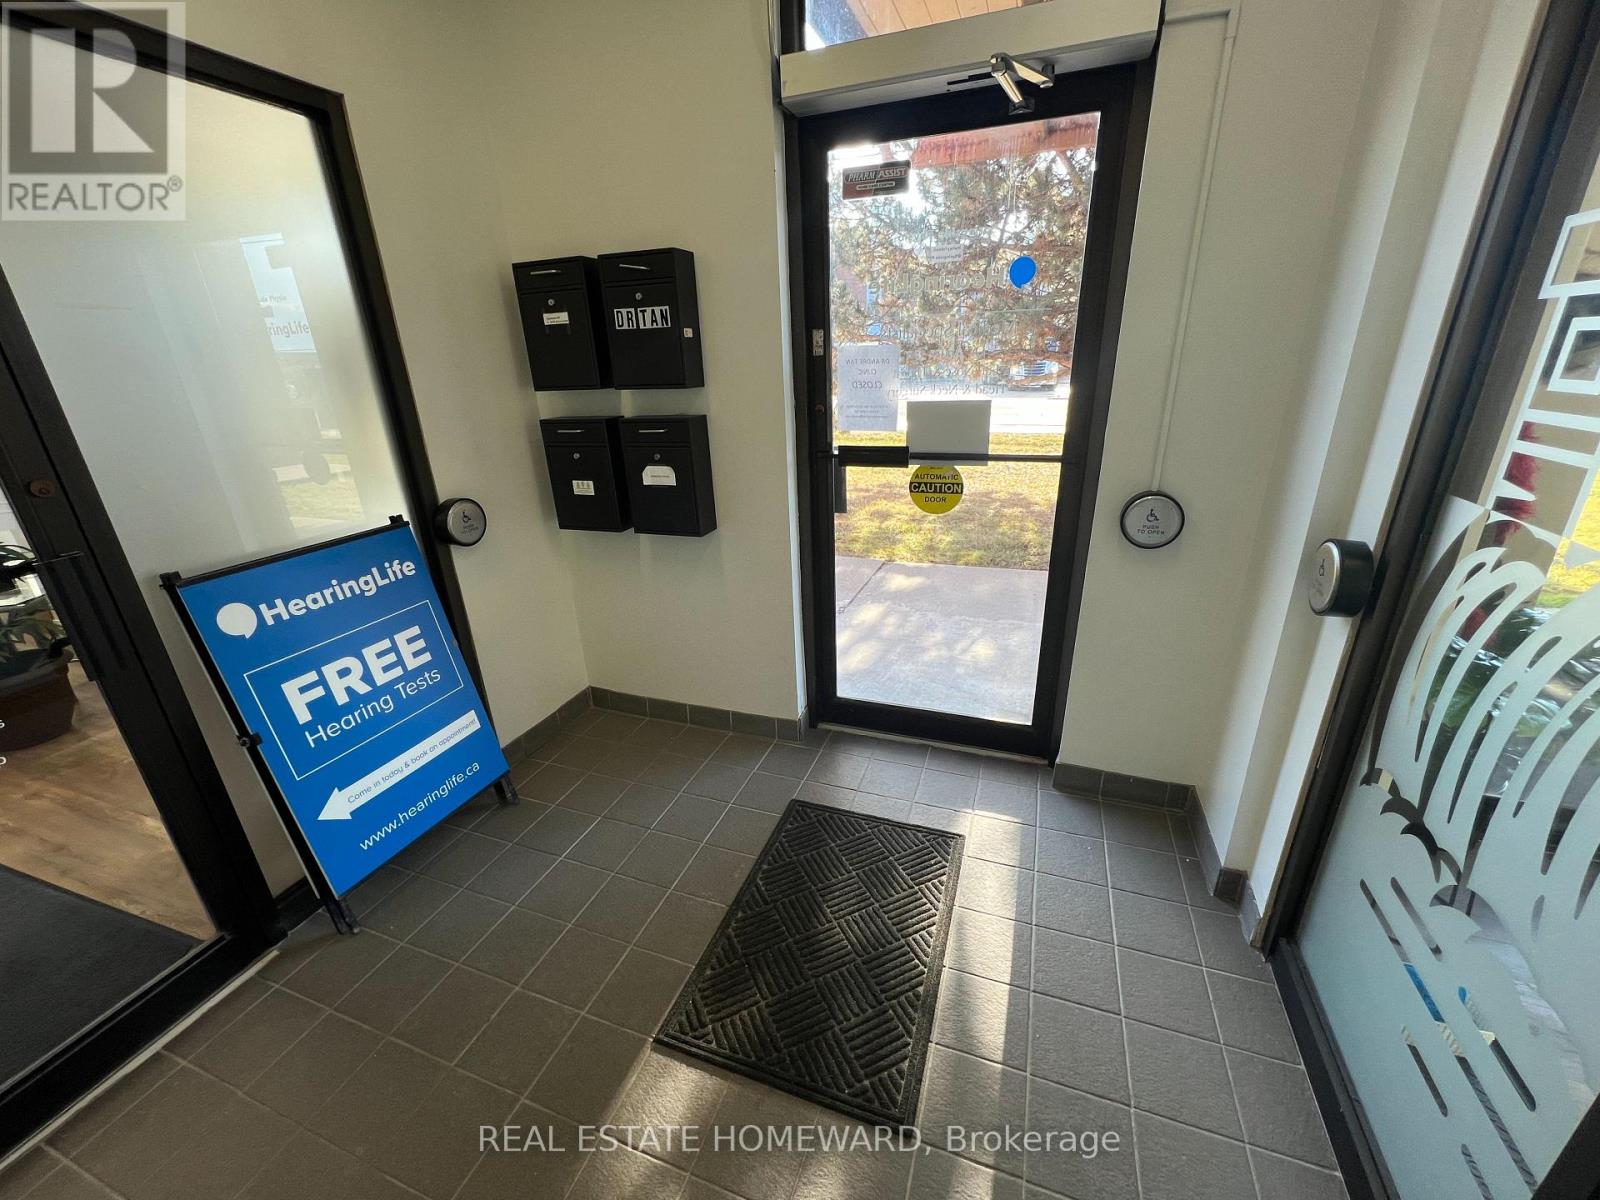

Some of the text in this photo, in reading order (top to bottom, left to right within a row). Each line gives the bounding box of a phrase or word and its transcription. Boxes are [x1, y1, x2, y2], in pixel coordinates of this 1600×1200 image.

[878, 168, 906, 178] ASSIST
[616, 307, 670, 329] DR TAN
[911, 482, 962, 493] CAUTION
[915, 473, 959, 481] AUTOMATIC
[258, 559, 416, 626] HearingLife
[280, 624, 433, 726] FREE
[304, 668, 442, 749] Hearing Tests
[347, 785, 373, 804] Come
[373, 780, 382, 789] in
[382, 766, 405, 784] today
[404, 760, 411, 769] &
[410, 749, 429, 765] book
[429, 743, 438, 753] an
[359, 761, 481, 851] www.hearinglife.ca
